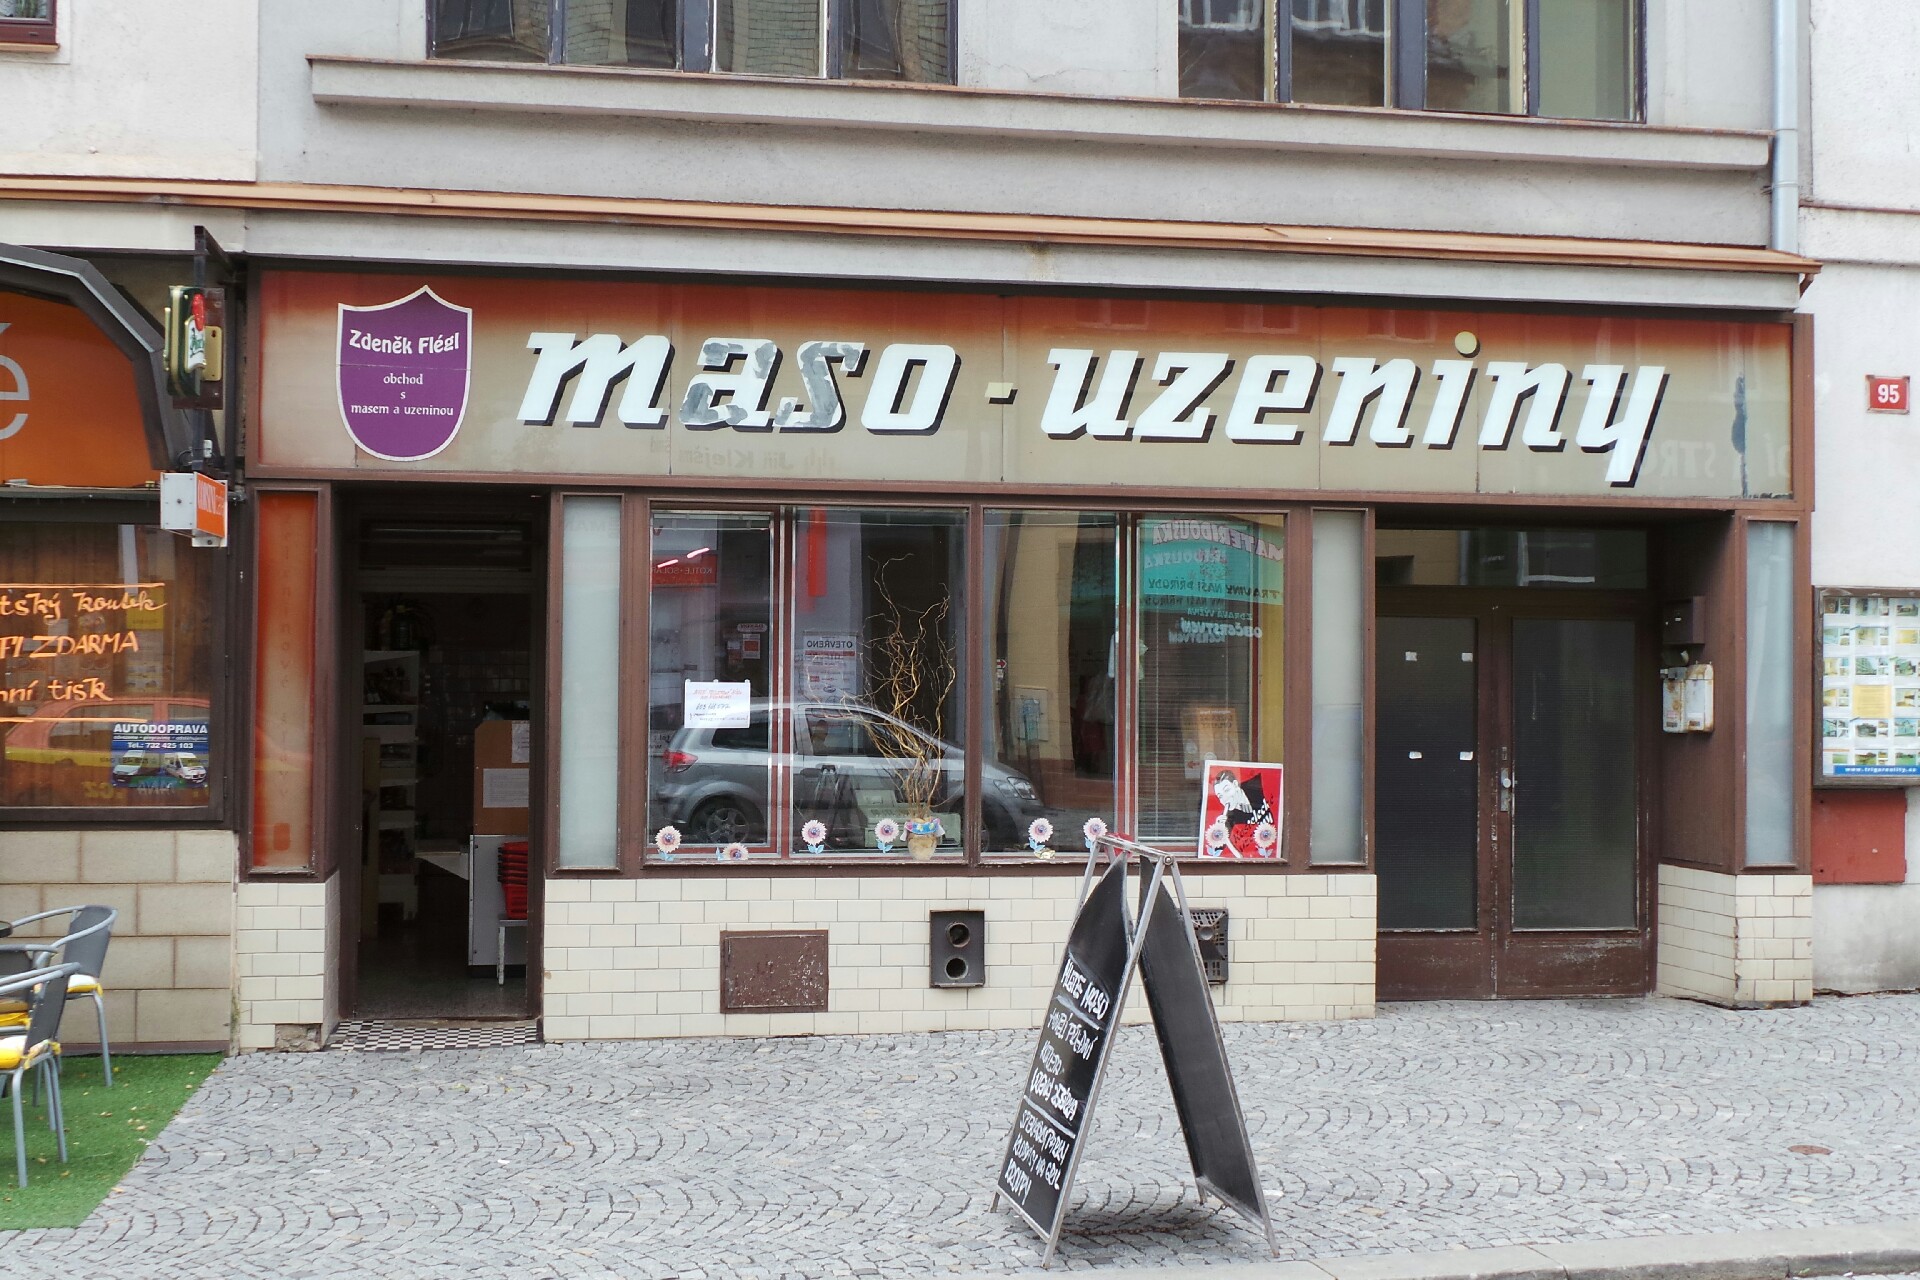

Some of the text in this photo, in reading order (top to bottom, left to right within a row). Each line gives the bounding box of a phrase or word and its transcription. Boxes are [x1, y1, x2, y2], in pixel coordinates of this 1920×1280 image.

[349, 330, 459, 354] Zdeněk Flégl
[383, 373, 423, 384] obchod
[400, 391, 406, 400] s
[1877, 383, 1900, 404] 95
[351, 404, 454, 416] masem a uzeninou
[517, 332, 962, 435] maso
[1039, 331, 1670, 487] uzeniny
[29, 631, 139, 658] ZDARMA
[47, 677, 113, 701] tisk
[113, 723, 208, 733] AUTODOPRAVA
